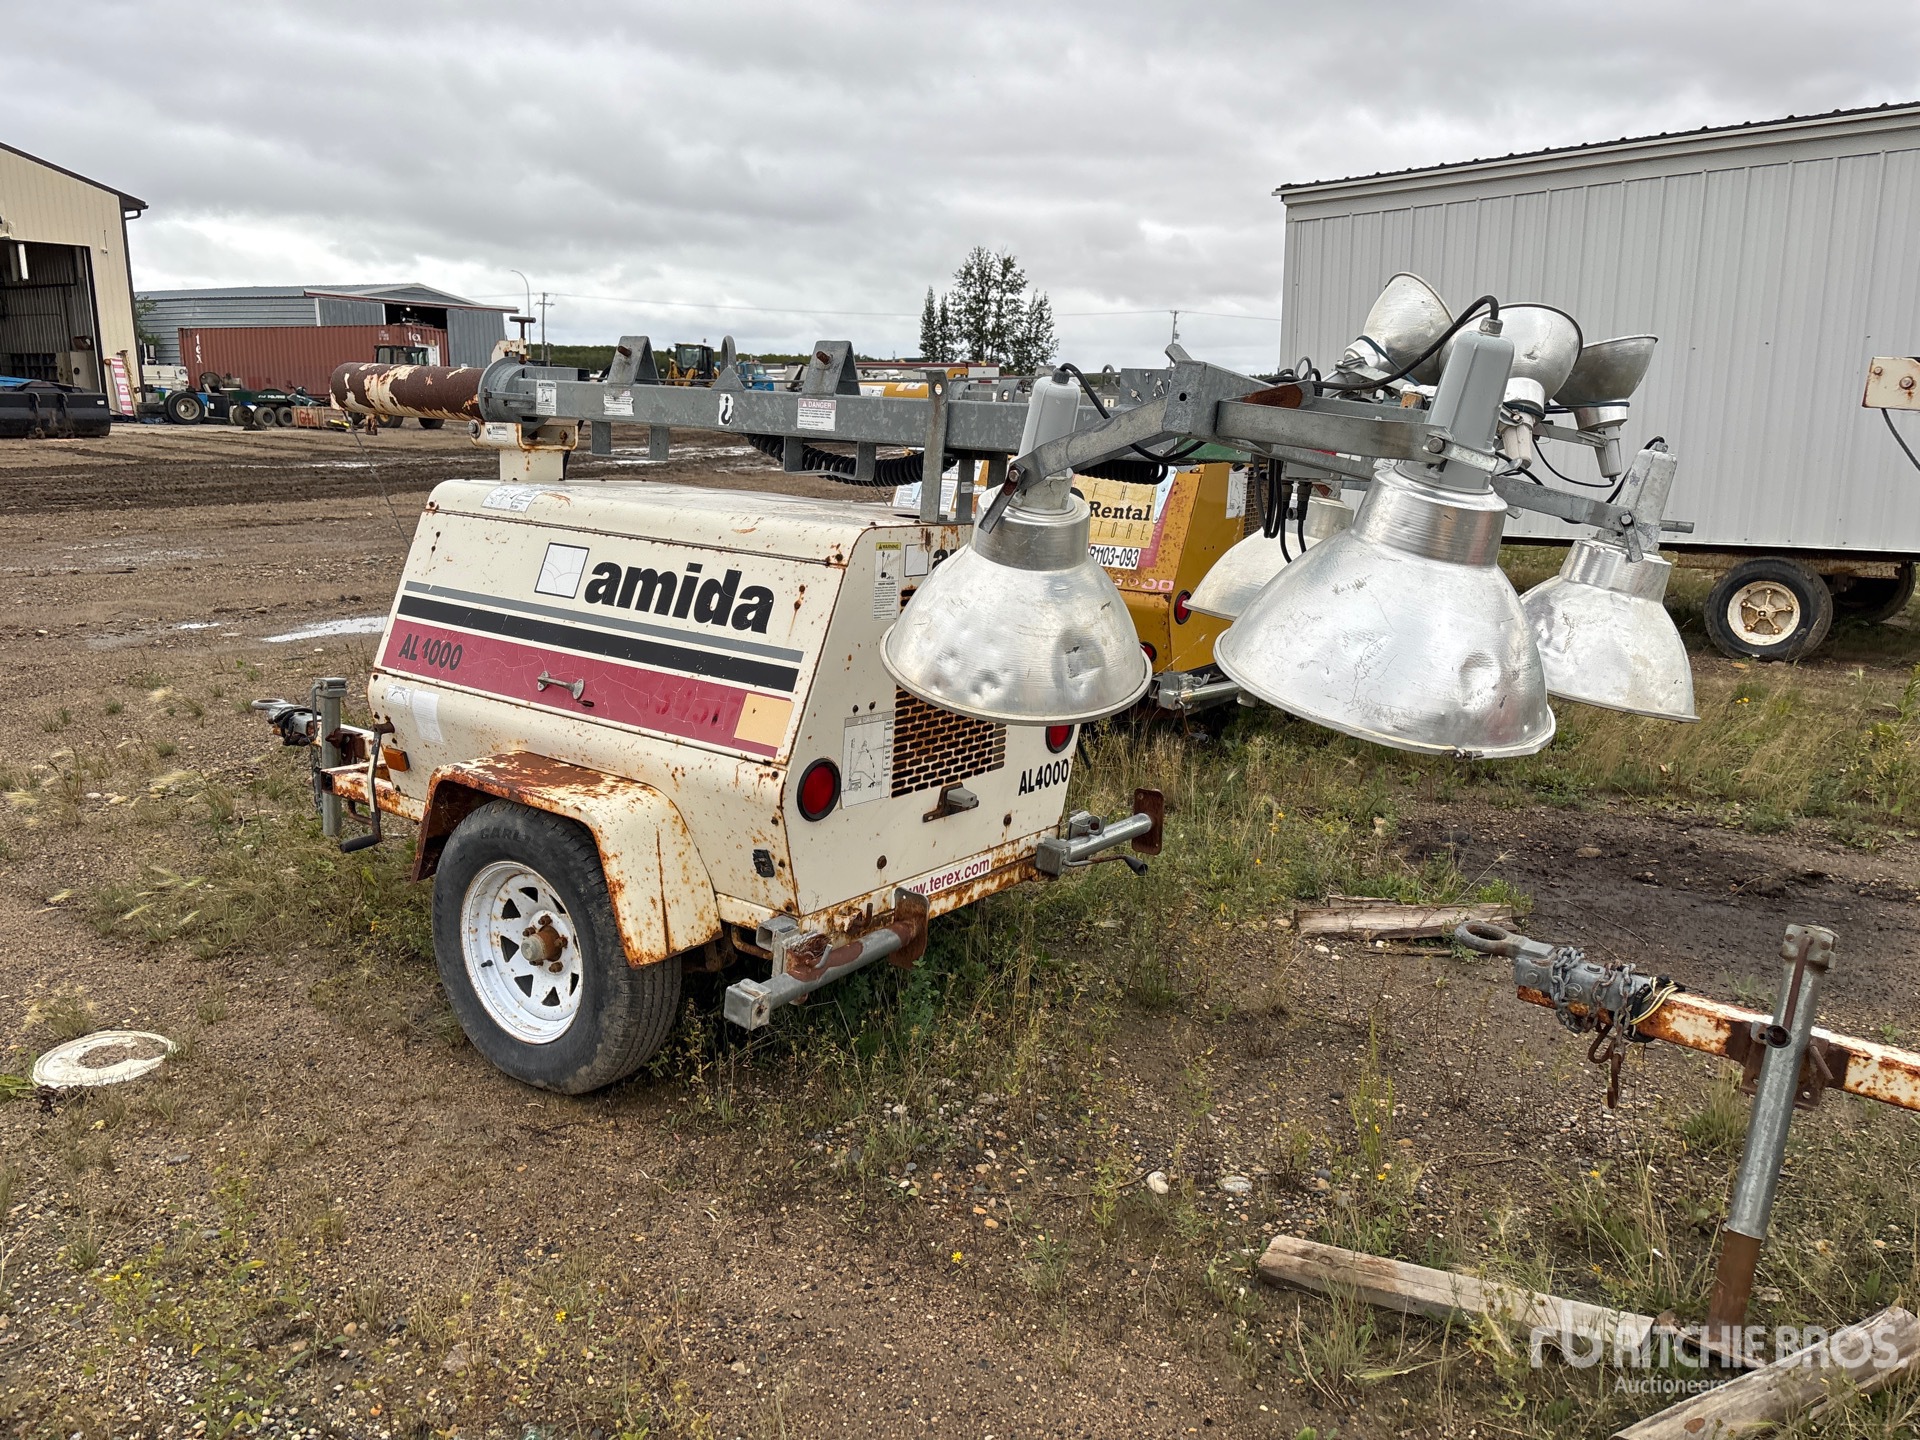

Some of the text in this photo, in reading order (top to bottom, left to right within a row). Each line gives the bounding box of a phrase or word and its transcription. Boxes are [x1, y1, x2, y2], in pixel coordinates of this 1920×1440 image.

[808, 401, 832, 409] DANGER
[1088, 501, 1152, 521] Rental
[1097, 521, 1147, 540] TORE
[584, 561, 775, 635] amida
[1018, 758, 1069, 796] AL4000
